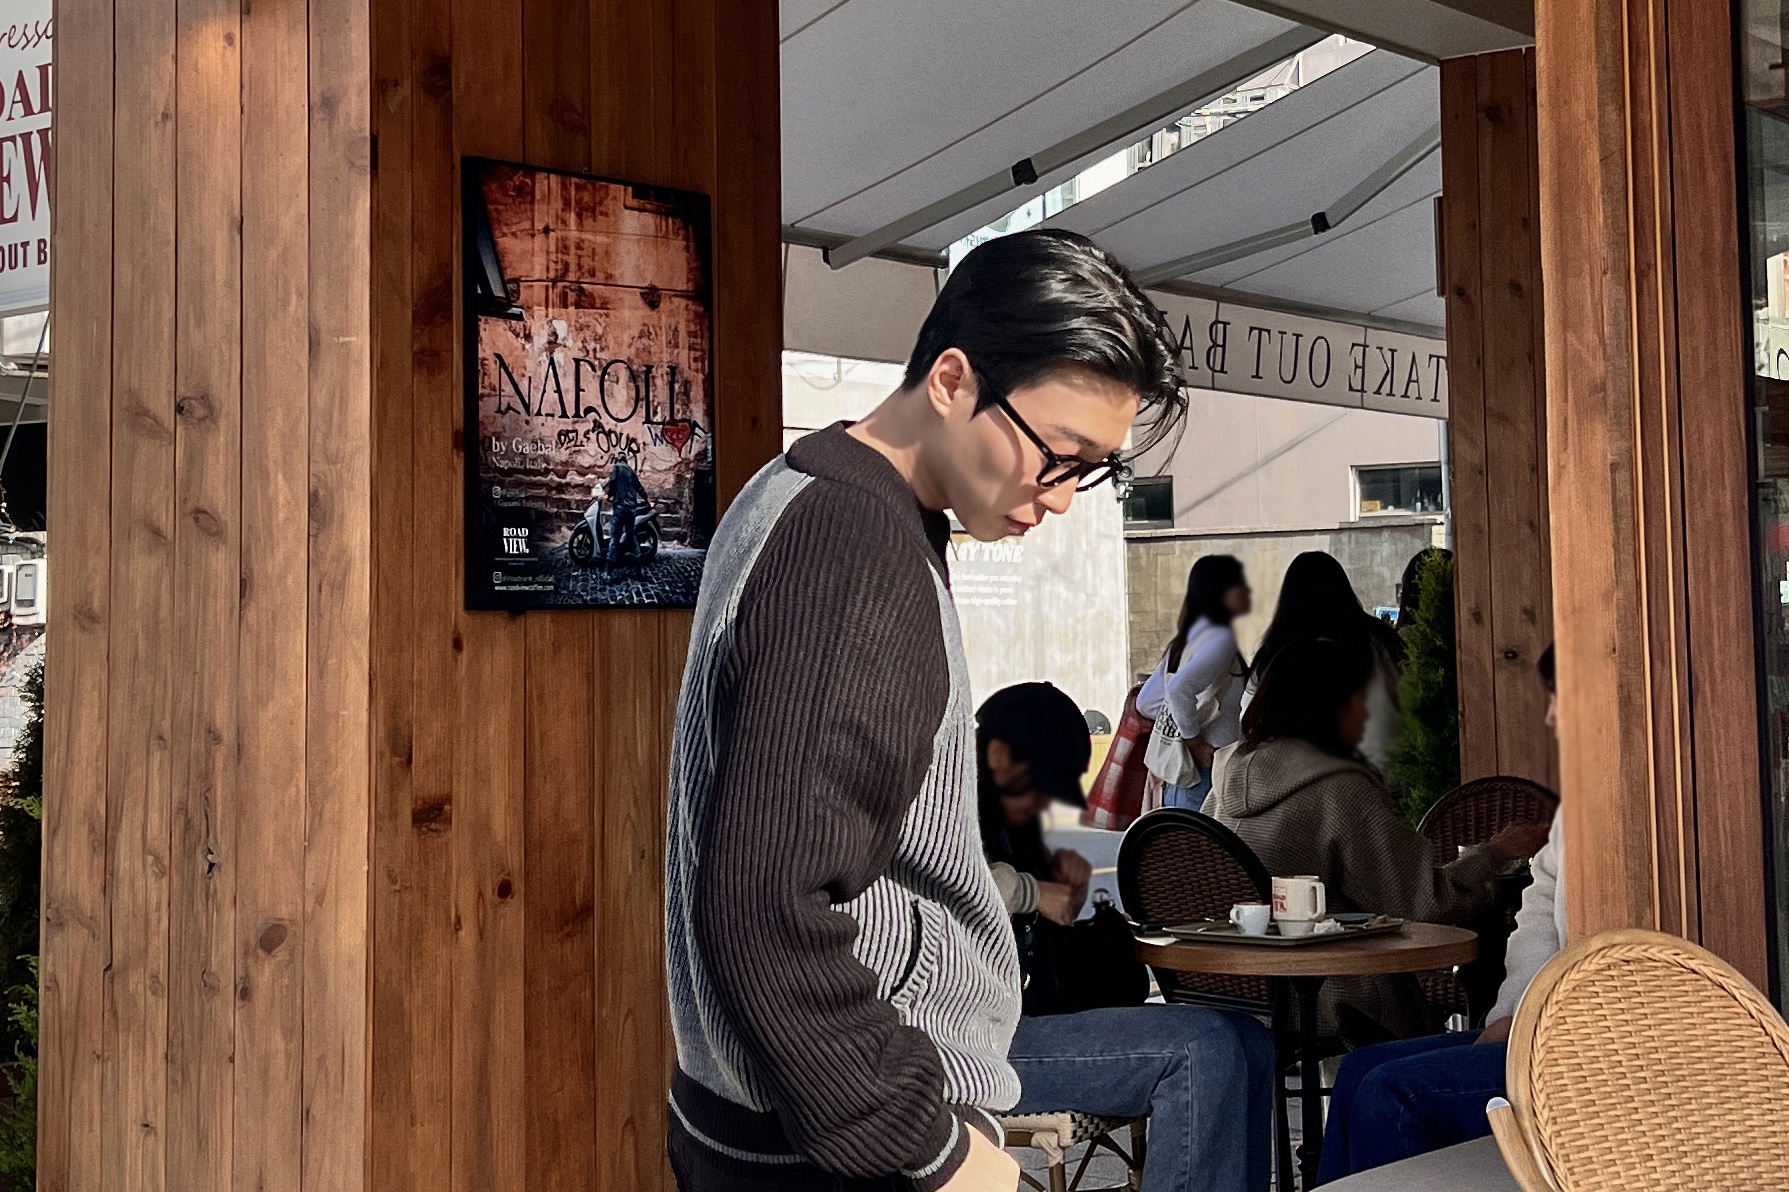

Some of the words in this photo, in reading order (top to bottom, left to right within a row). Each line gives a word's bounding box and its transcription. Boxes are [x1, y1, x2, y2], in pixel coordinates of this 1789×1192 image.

[493, 352, 679, 426] NAPOLI
[492, 436, 508, 455] by
[503, 527, 529, 537] ROAD
